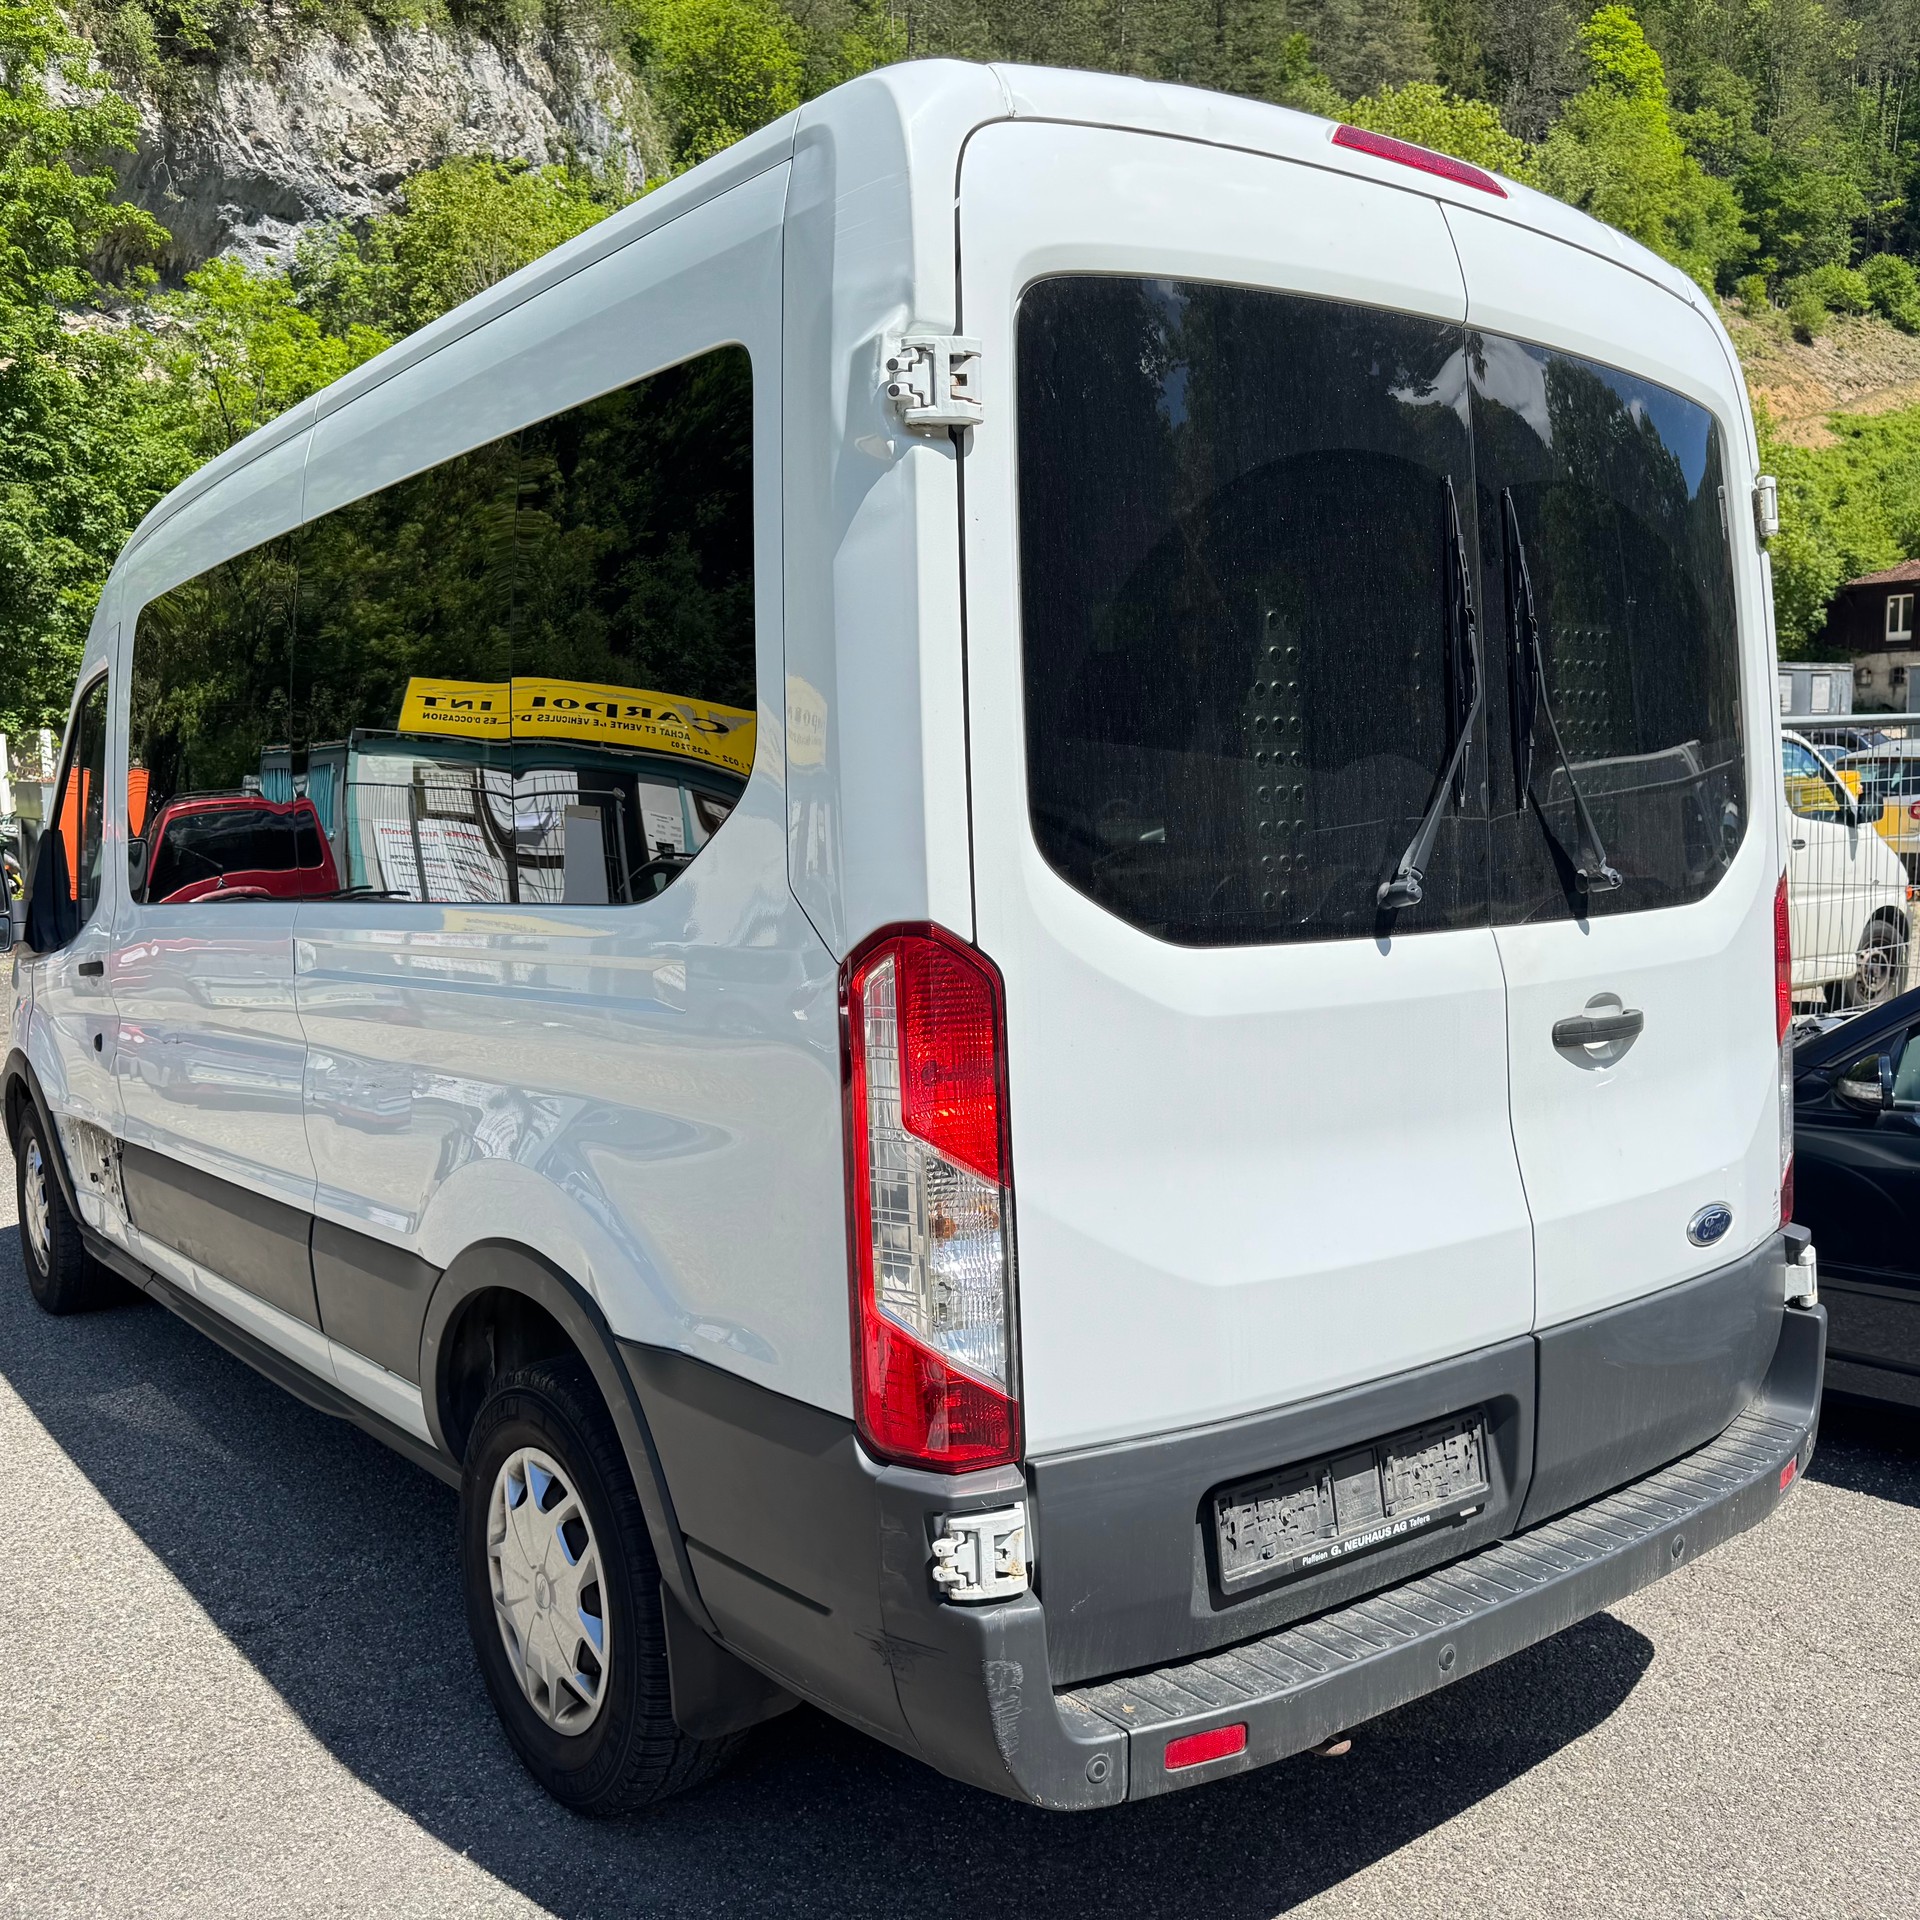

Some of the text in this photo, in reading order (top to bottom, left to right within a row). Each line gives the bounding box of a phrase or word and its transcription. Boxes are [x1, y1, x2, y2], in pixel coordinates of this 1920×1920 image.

[1702, 1213, 1727, 1238] Ford
[1302, 1514, 1431, 1566] Plaffeien G. NEUHAUS AG Tafers
